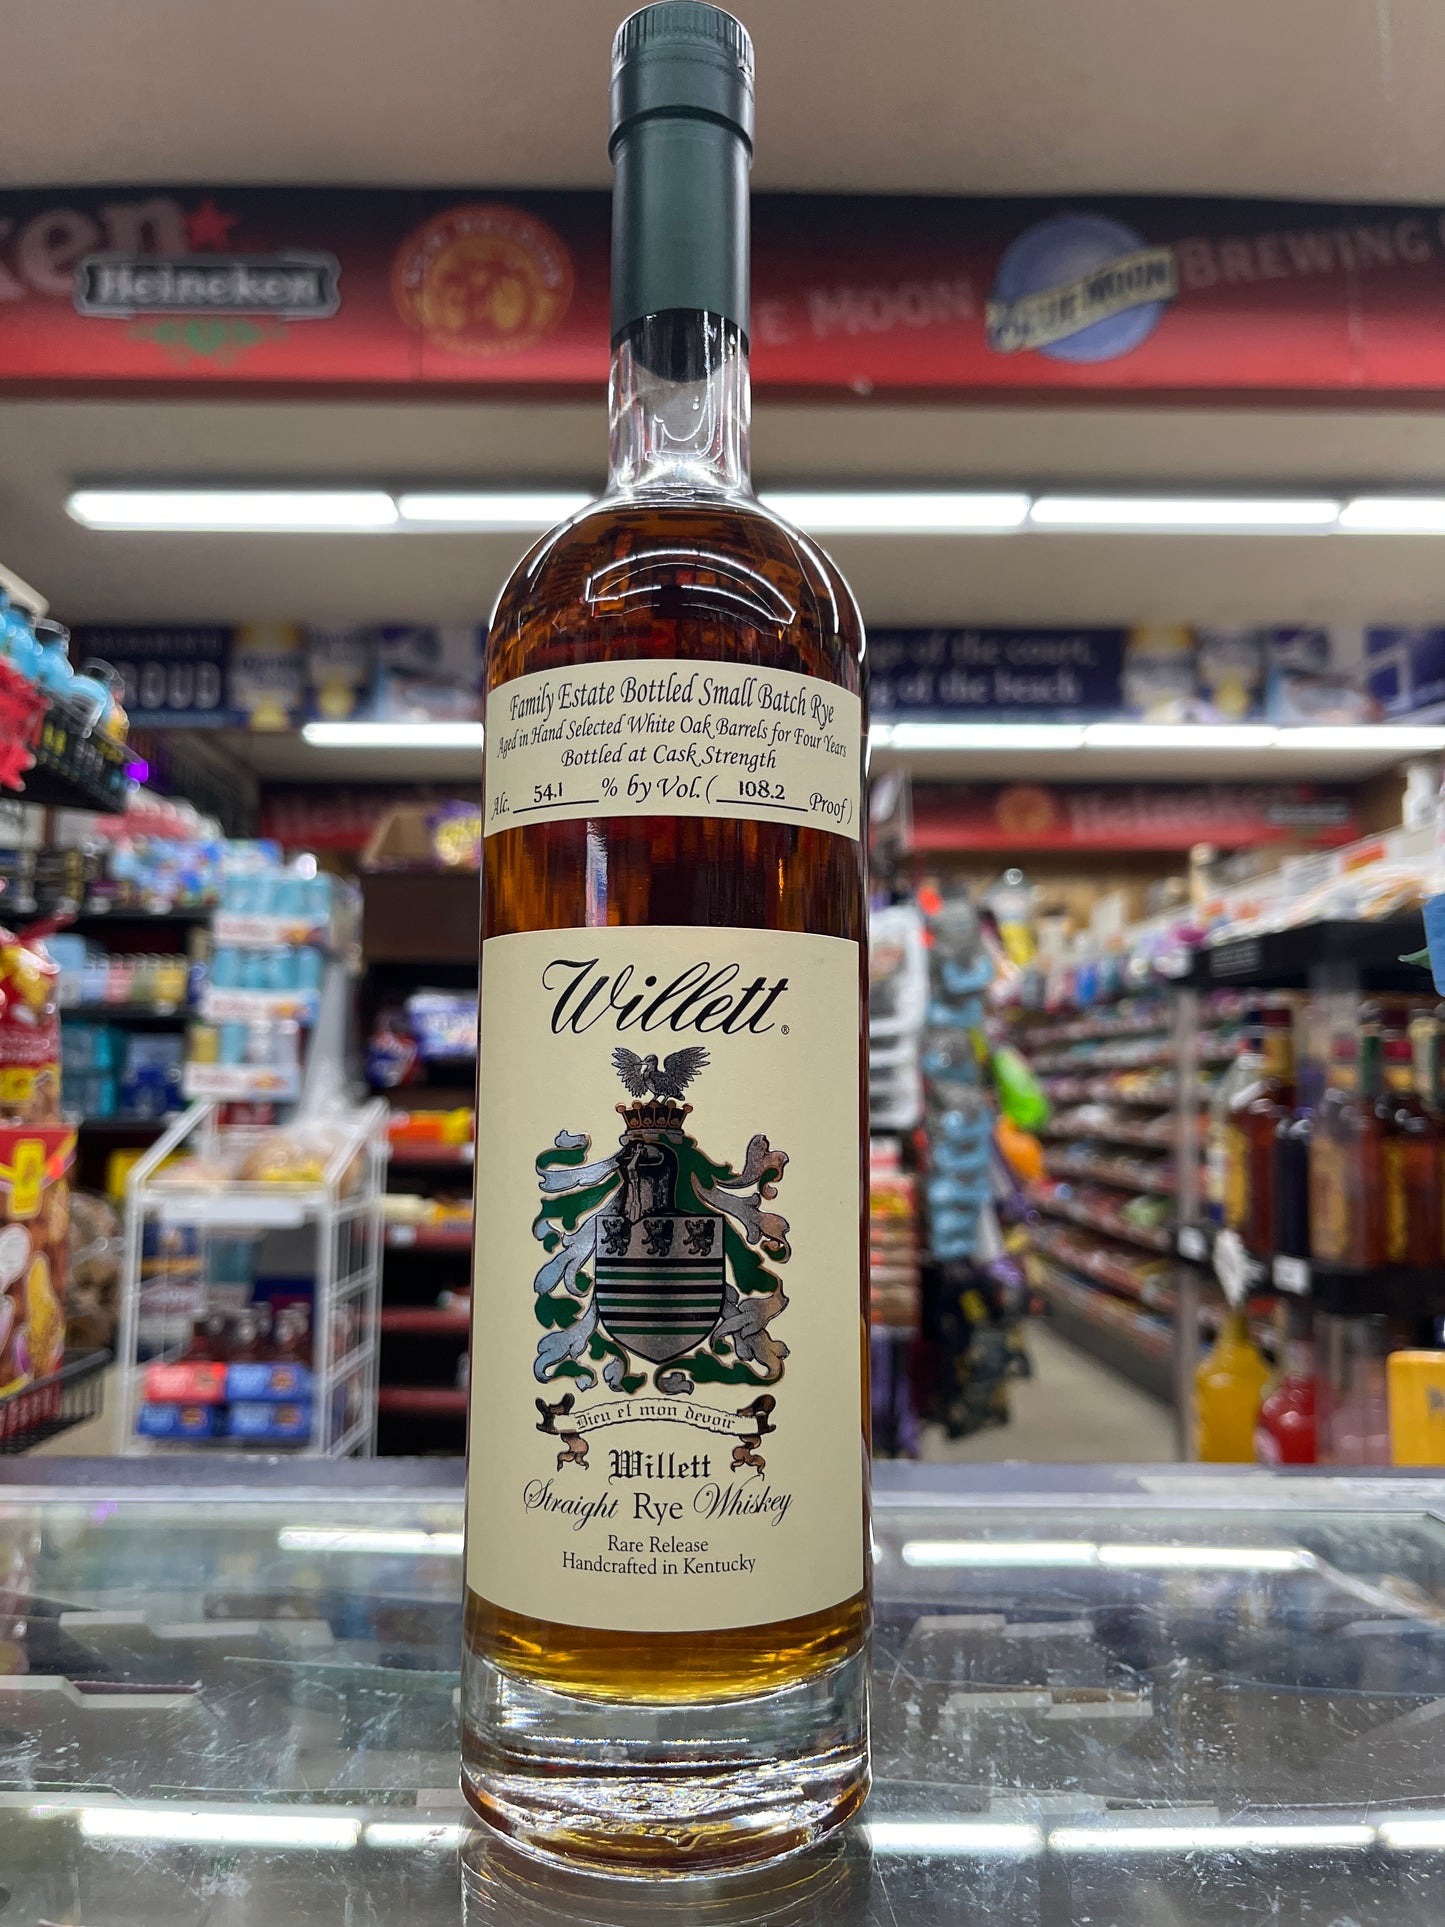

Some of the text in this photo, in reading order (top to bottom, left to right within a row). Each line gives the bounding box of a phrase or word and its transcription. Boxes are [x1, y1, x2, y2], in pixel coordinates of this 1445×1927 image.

[1180, 221, 1430, 287] BREWING
[92, 262, 318, 305] Heineken
[808, 276, 978, 340] MOON
[509, 672, 834, 730] Family Estate Bottled Small Batch Rye
[497, 712, 847, 759] Aged in Hand Selected White Oak Barrels for Four Years
[561, 742, 777, 773] Bottled at Cask Strength
[491, 792, 510, 820] Alc.
[533, 781, 563, 803] 54.1
[602, 777, 618, 797] %
[627, 773, 651, 803] by
[656, 775, 702, 798] Vol.
[738, 779, 785, 800] 108.2
[809, 792, 853, 824] Proof)
[542, 958, 789, 1035] Willett
[575, 1403, 736, 1429] Dieu et mon devoir
[608, 1449, 711, 1485] Willett
[523, 1474, 793, 1531] Straight Rye Whiskey
[562, 1551, 756, 1575] Handcrafted in Kentucky
[607, 1534, 709, 1552] Rare Release
